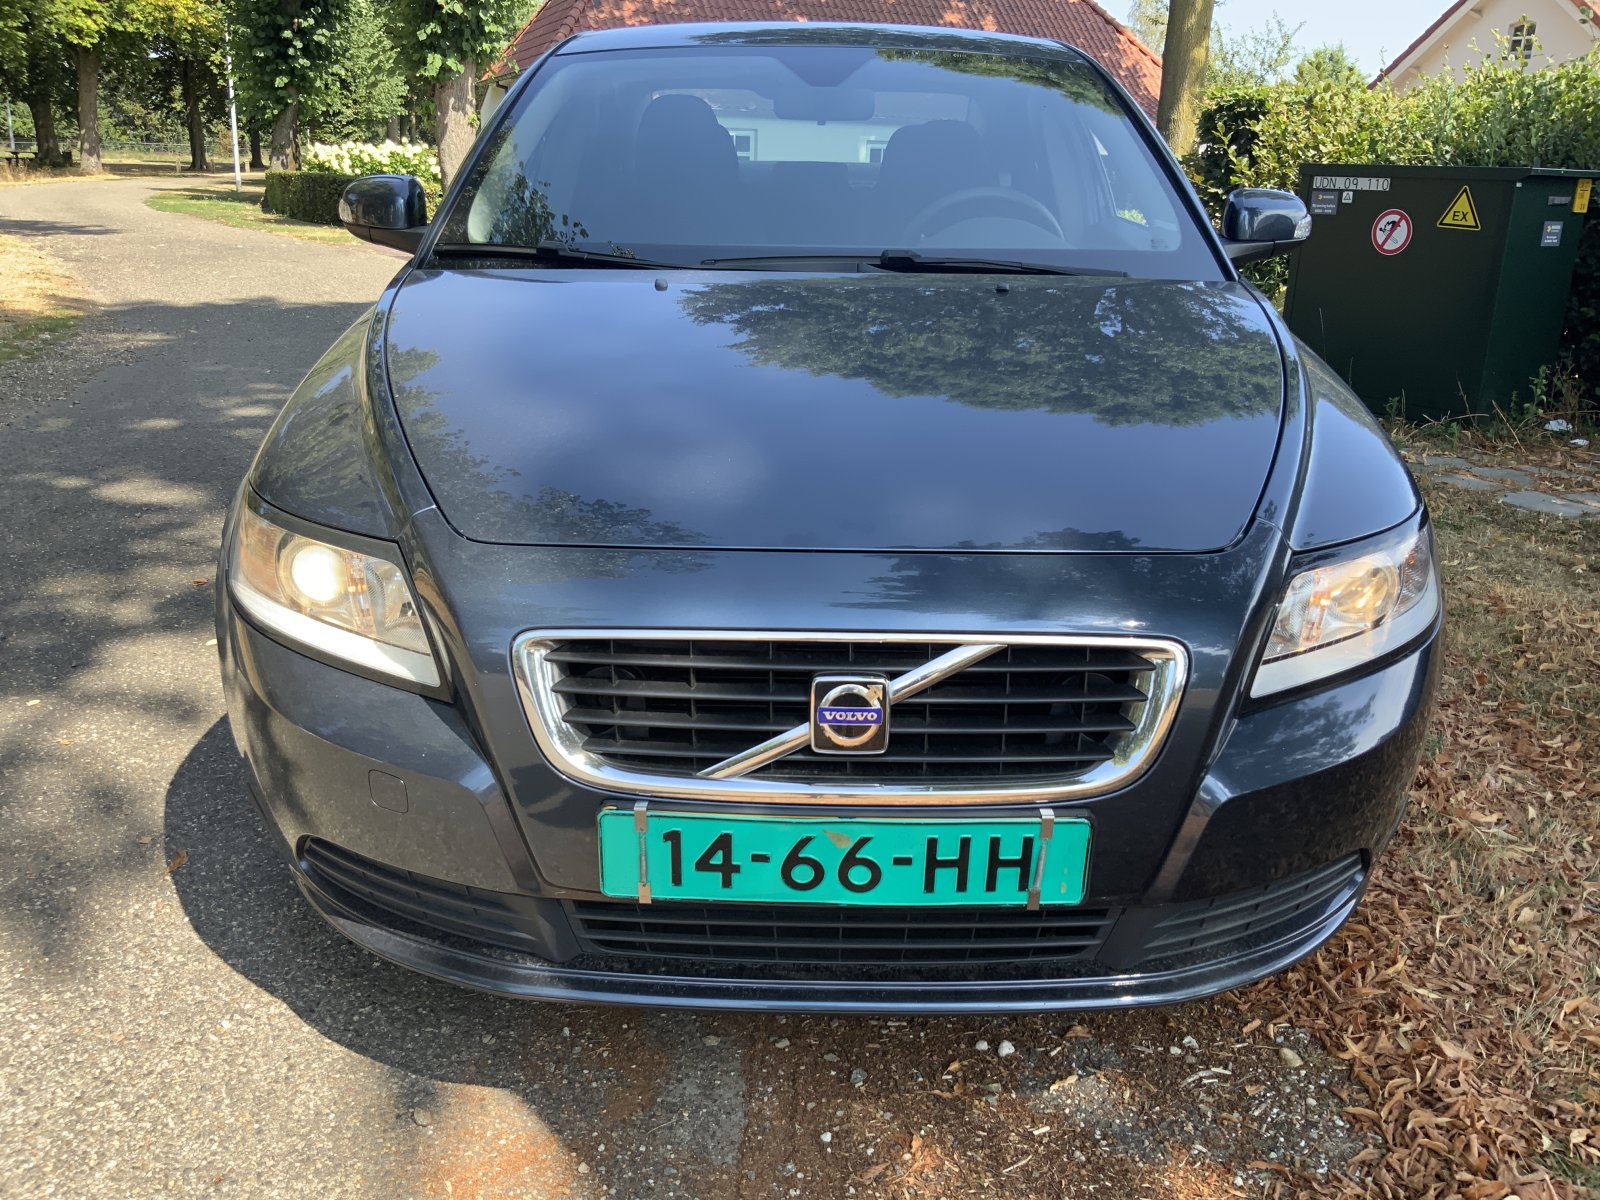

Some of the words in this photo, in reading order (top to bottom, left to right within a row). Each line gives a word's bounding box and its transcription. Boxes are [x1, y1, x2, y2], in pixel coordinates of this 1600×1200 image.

[1314, 177, 1390, 191] UDN.09.110
[1452, 210, 1469, 222] EX
[822, 711, 878, 721] VOLVO
[661, 829, 1034, 893] 14-66-HH
